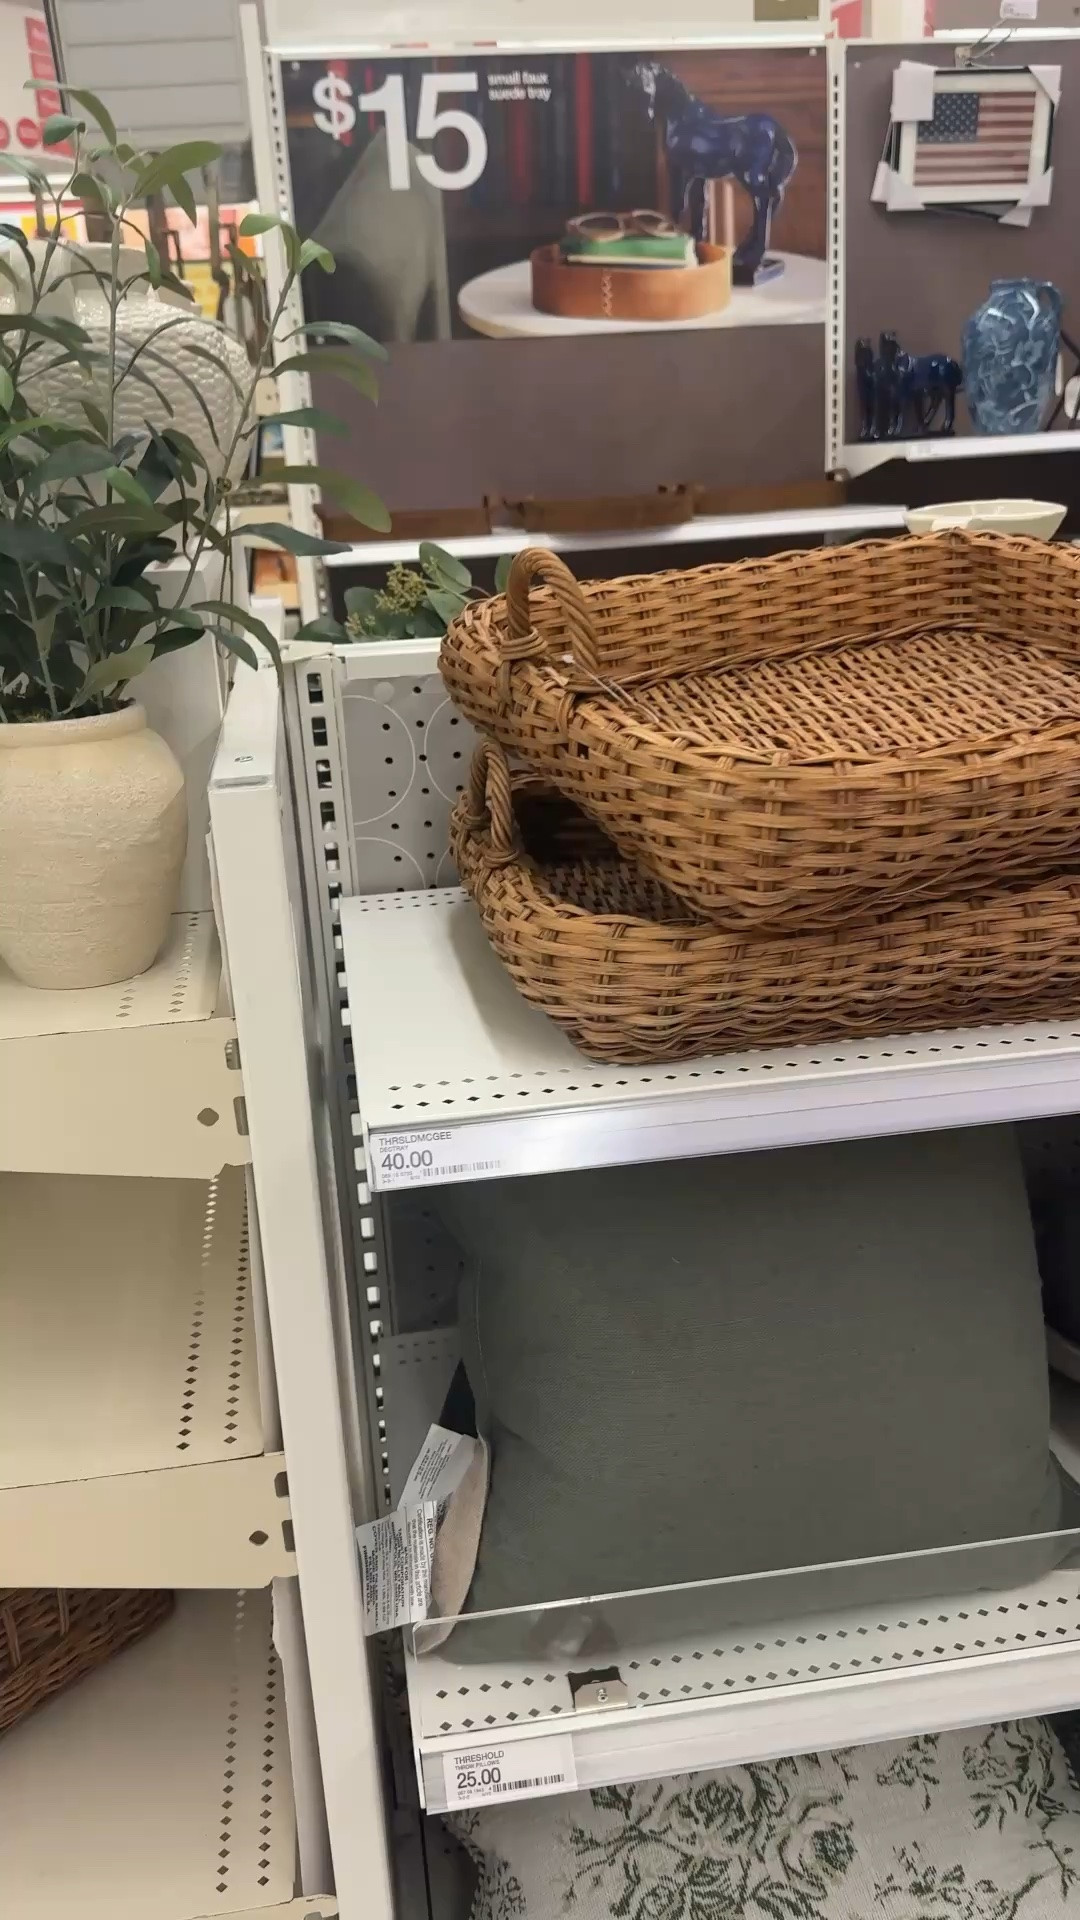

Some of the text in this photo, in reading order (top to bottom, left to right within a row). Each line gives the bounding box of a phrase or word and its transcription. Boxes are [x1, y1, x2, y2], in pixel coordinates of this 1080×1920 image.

[487, 71, 549, 86] small faux
[488, 87, 551, 102] suede tray
[312, 72, 488, 191] $15
[379, 1132, 452, 1146] THRSLDMCGEE
[381, 1150, 433, 1171] 40.00
[454, 1750, 504, 1765] THRESHOLD
[456, 1767, 501, 1789] 25.00
